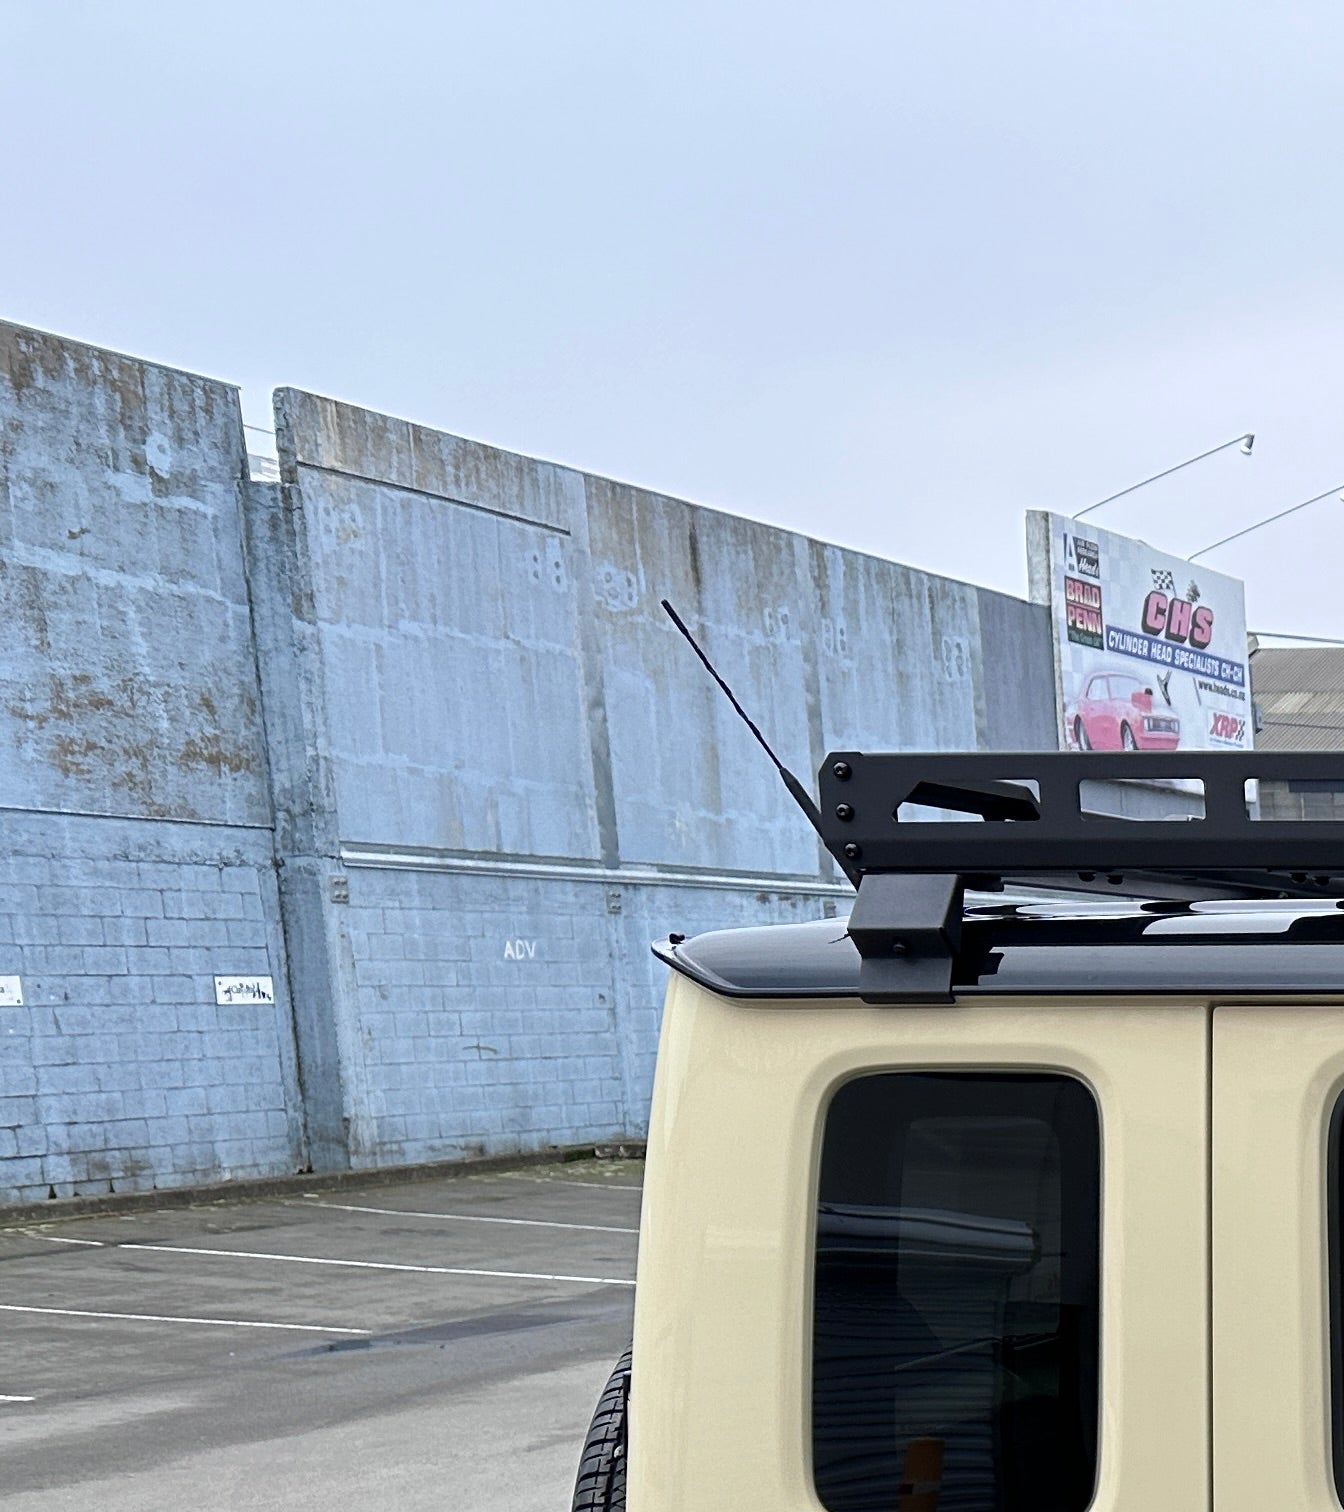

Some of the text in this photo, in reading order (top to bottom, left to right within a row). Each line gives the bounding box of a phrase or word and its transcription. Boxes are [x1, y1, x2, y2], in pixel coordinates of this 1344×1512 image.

[1066, 578, 1100, 609] BRAD
[1068, 604, 1102, 635] PENN
[1142, 590, 1213, 650] CHS
[1108, 630, 1149, 657] CYLINDER
[1151, 642, 1173, 664] HEAD
[1174, 648, 1220, 677] SPECIALISTS
[504, 940, 537, 960] ADV
